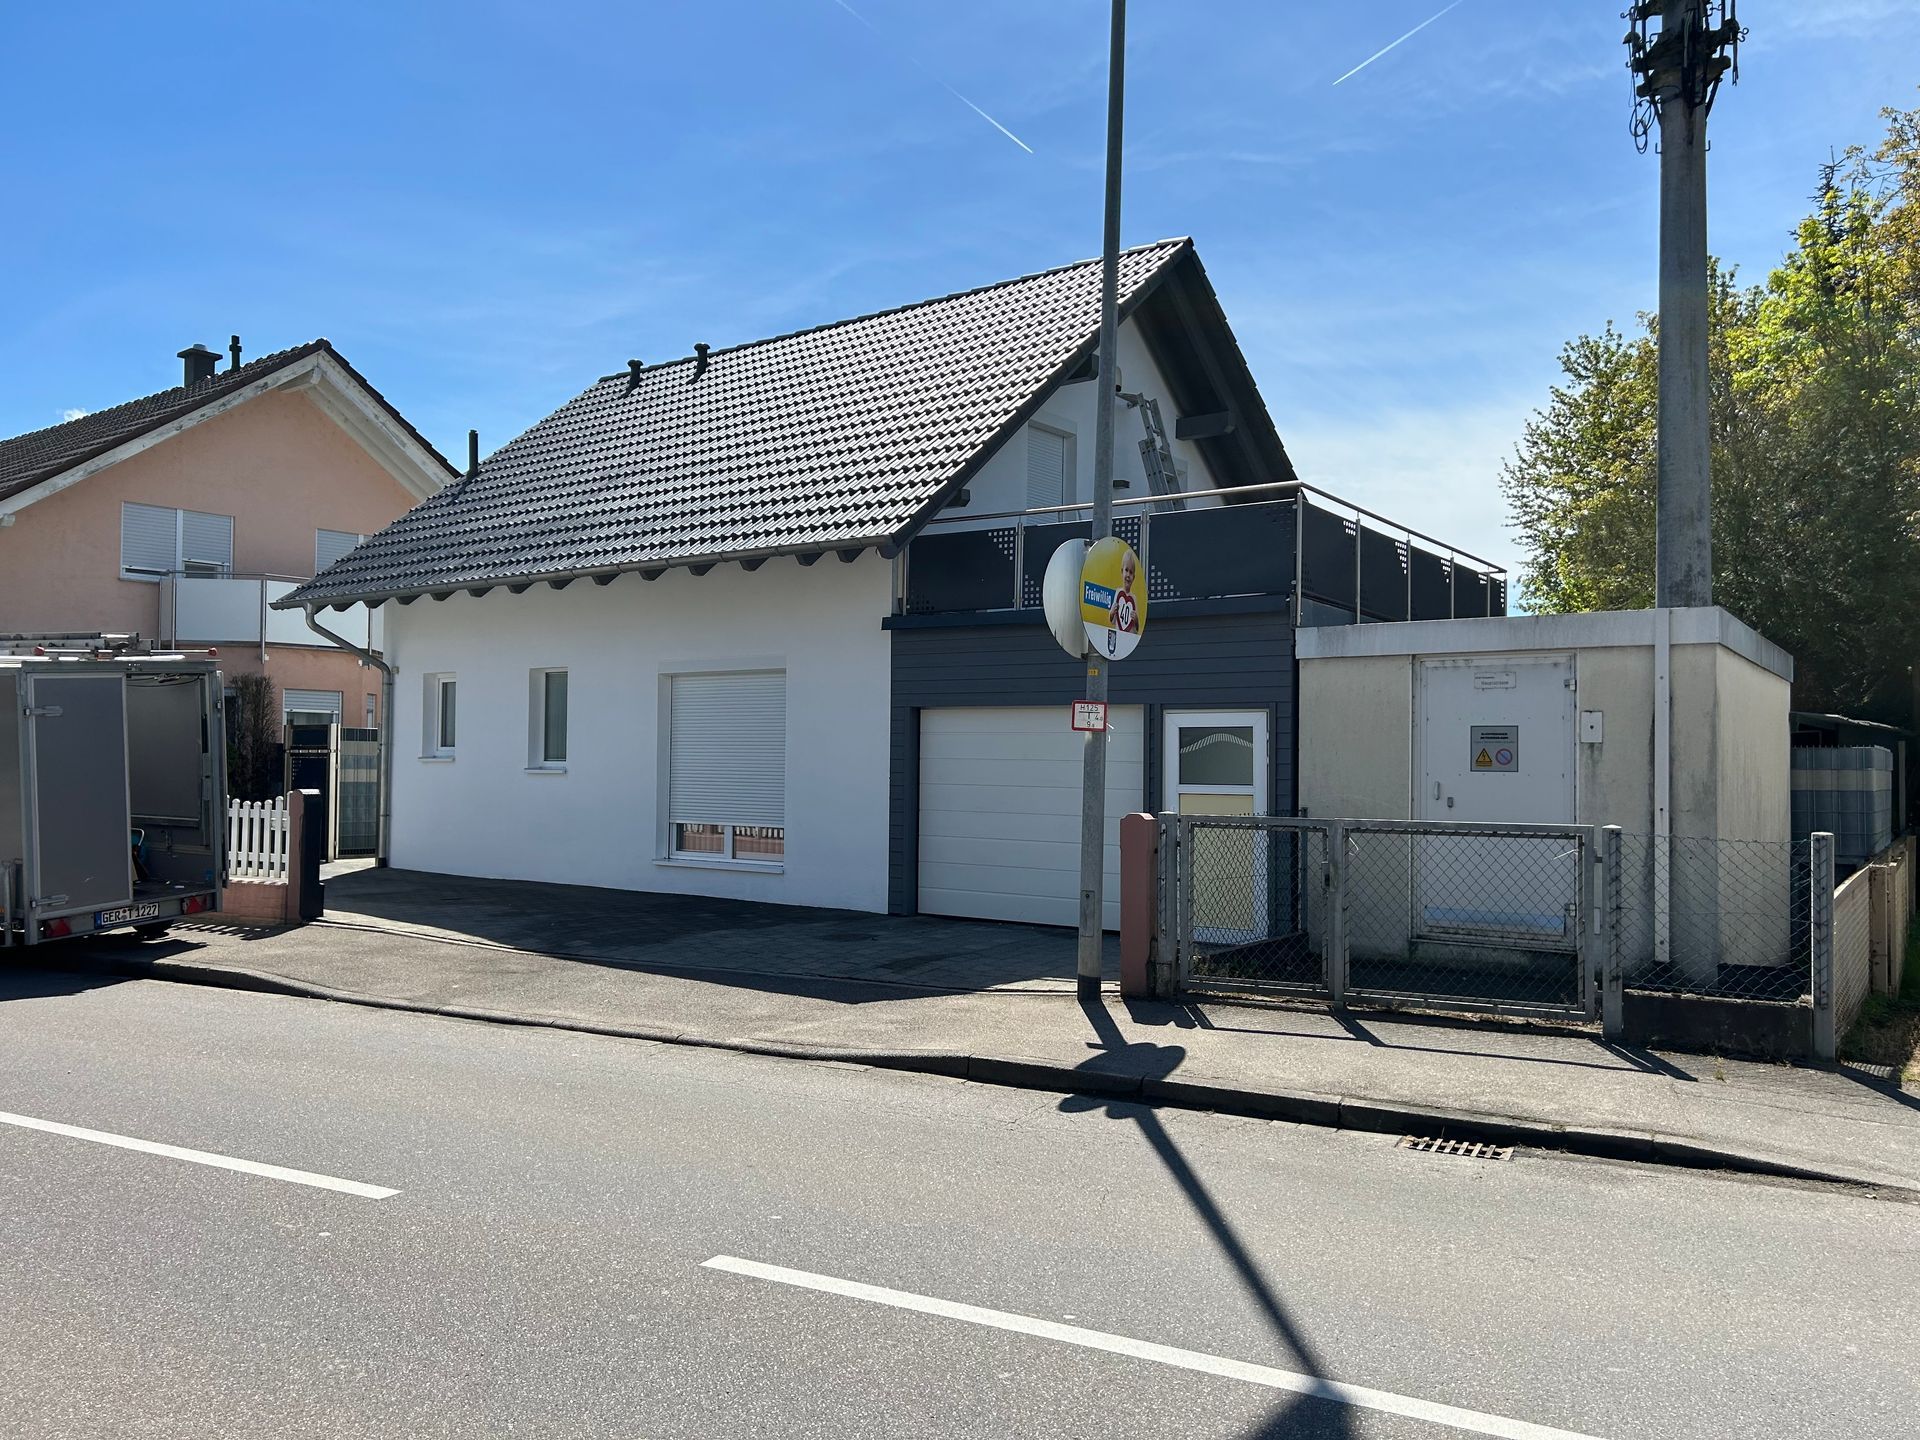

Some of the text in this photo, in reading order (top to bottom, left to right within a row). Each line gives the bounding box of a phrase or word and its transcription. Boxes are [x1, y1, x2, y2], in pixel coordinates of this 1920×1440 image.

[1085, 585, 1112, 608] Freiwillig
[1120, 603, 1130, 625] 40
[102, 904, 157, 923] GER T 1227
